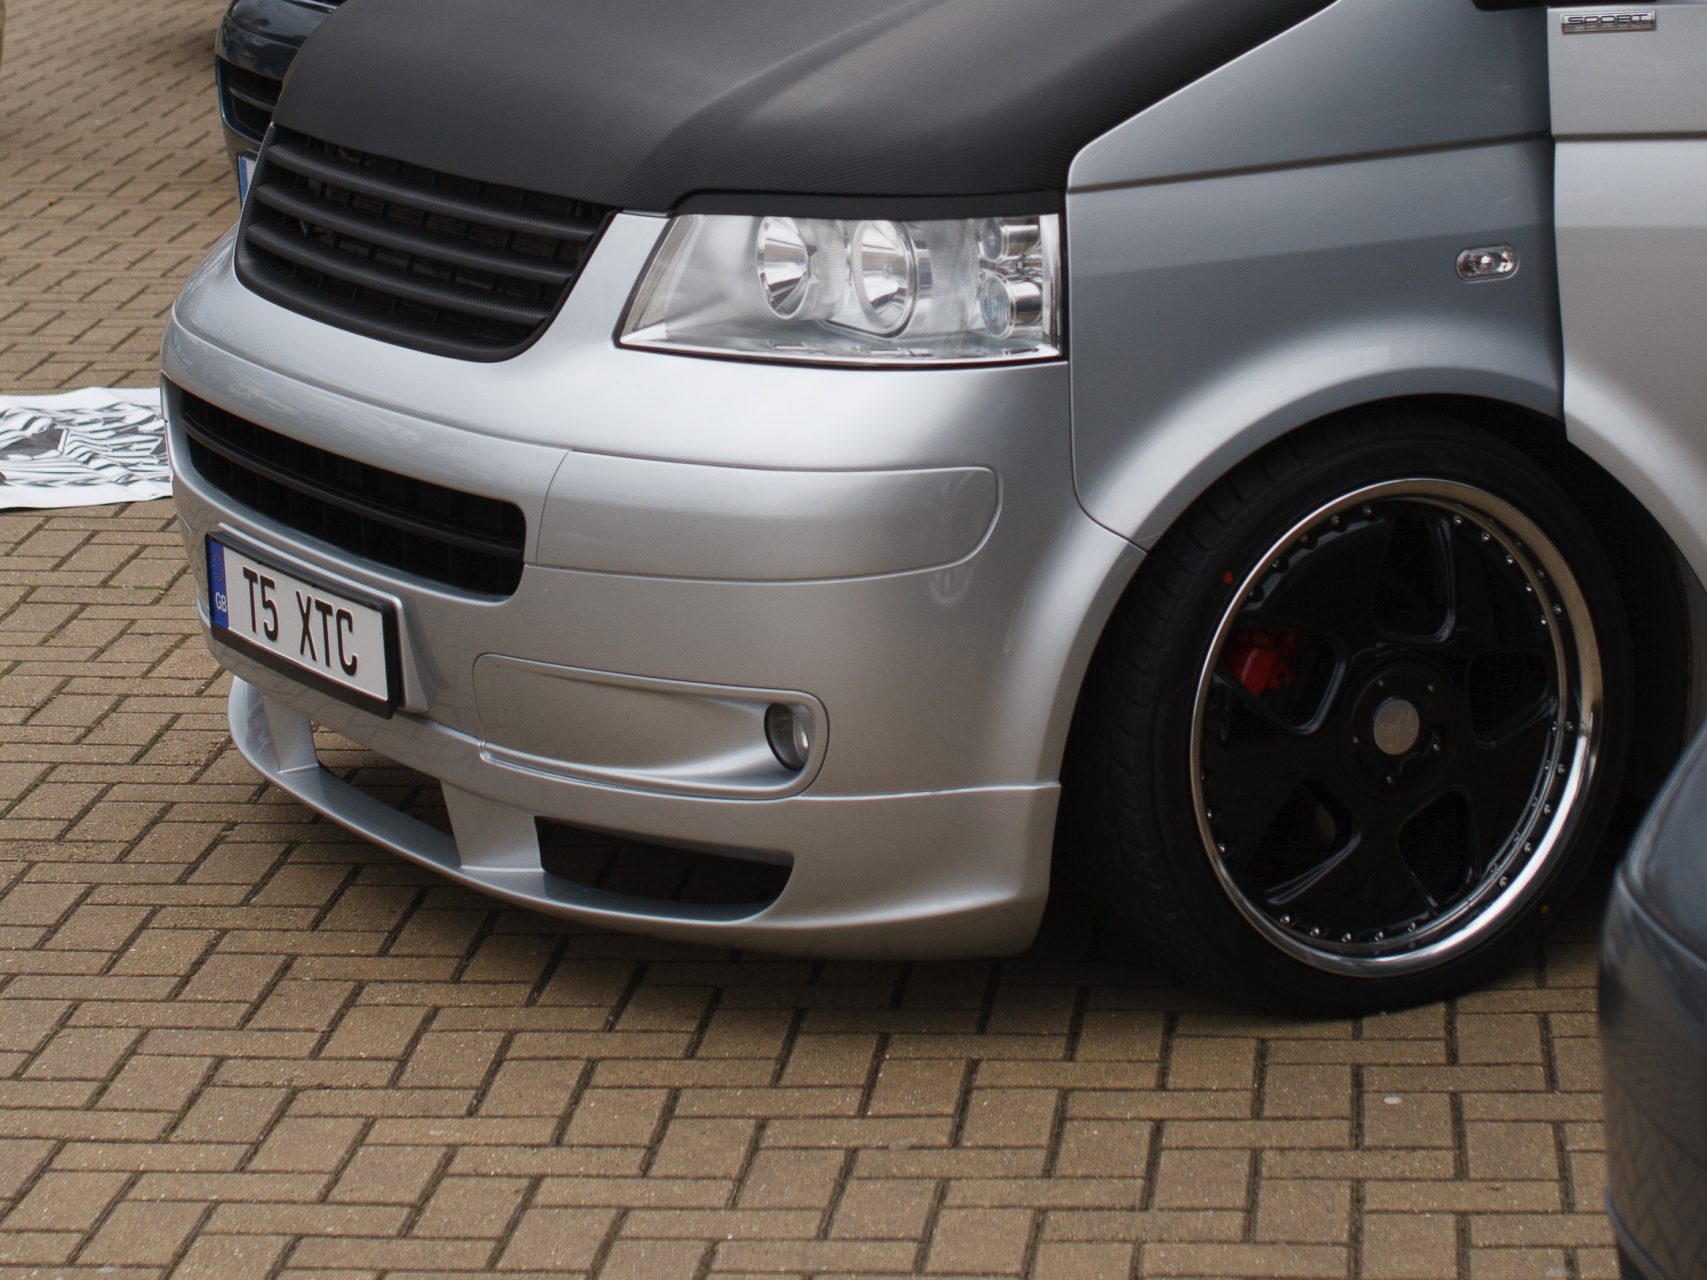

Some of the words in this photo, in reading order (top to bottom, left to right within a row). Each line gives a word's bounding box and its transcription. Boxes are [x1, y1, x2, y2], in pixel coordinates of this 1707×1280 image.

[1567, 13, 1649, 25] SPORT
[215, 592, 228, 613] GB
[243, 566, 279, 642] T5
[296, 590, 358, 676] XTC
